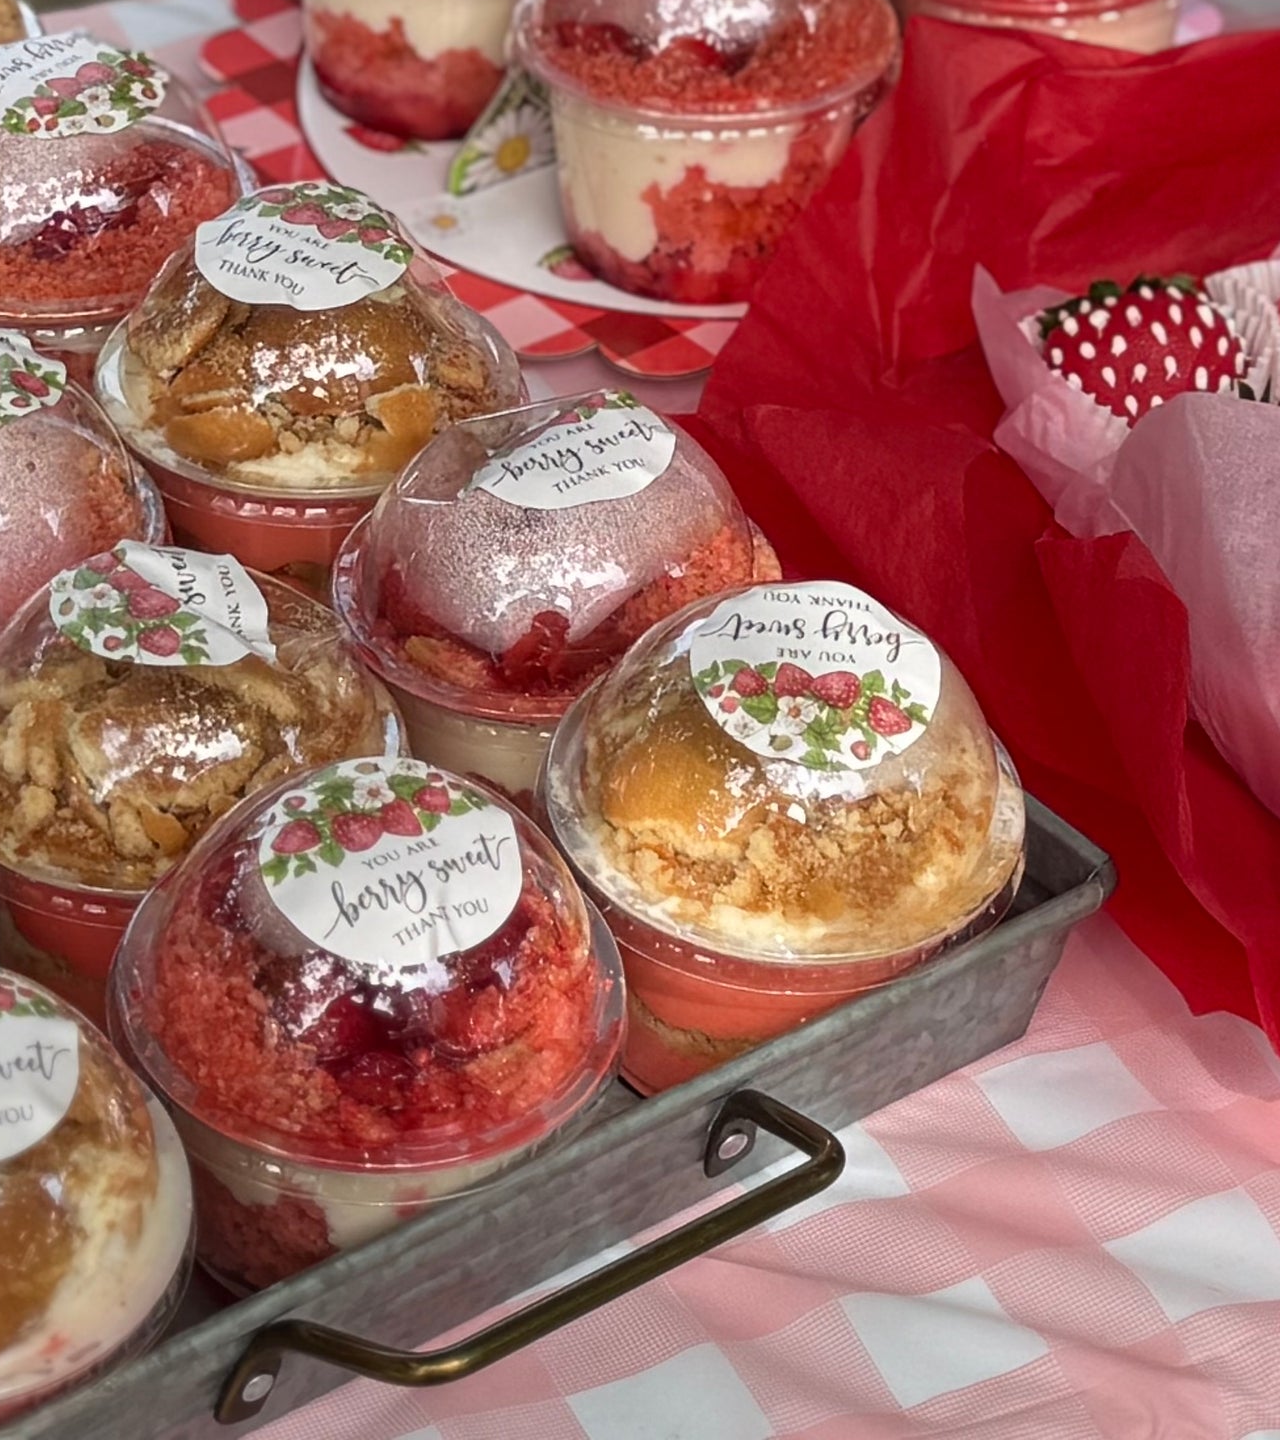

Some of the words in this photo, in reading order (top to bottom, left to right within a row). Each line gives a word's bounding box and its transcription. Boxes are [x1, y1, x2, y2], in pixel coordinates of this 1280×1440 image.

[201, 218, 287, 264] berry
[284, 246, 381, 286] sweet
[219, 258, 271, 284] THANK
[272, 272, 305, 297] YOU
[566, 422, 596, 438] ARE
[491, 446, 584, 488] berry
[584, 419, 662, 455] sweet
[551, 464, 610, 495] THANK
[613, 457, 646, 473] YOU
[216, 563, 238, 598] YOU
[762, 590, 801, 604] YOU
[808, 594, 872, 614] THANK
[698, 612, 807, 642] sweet
[813, 610, 928, 664] berry
[775, 646, 812, 660] ARE
[818, 652, 857, 665] YOU
[360, 848, 402, 872] YOU
[406, 836, 441, 857] ARE
[323, 868, 428, 941] berry
[426, 832, 512, 885] sweet
[452, 897, 490, 920] YOU
